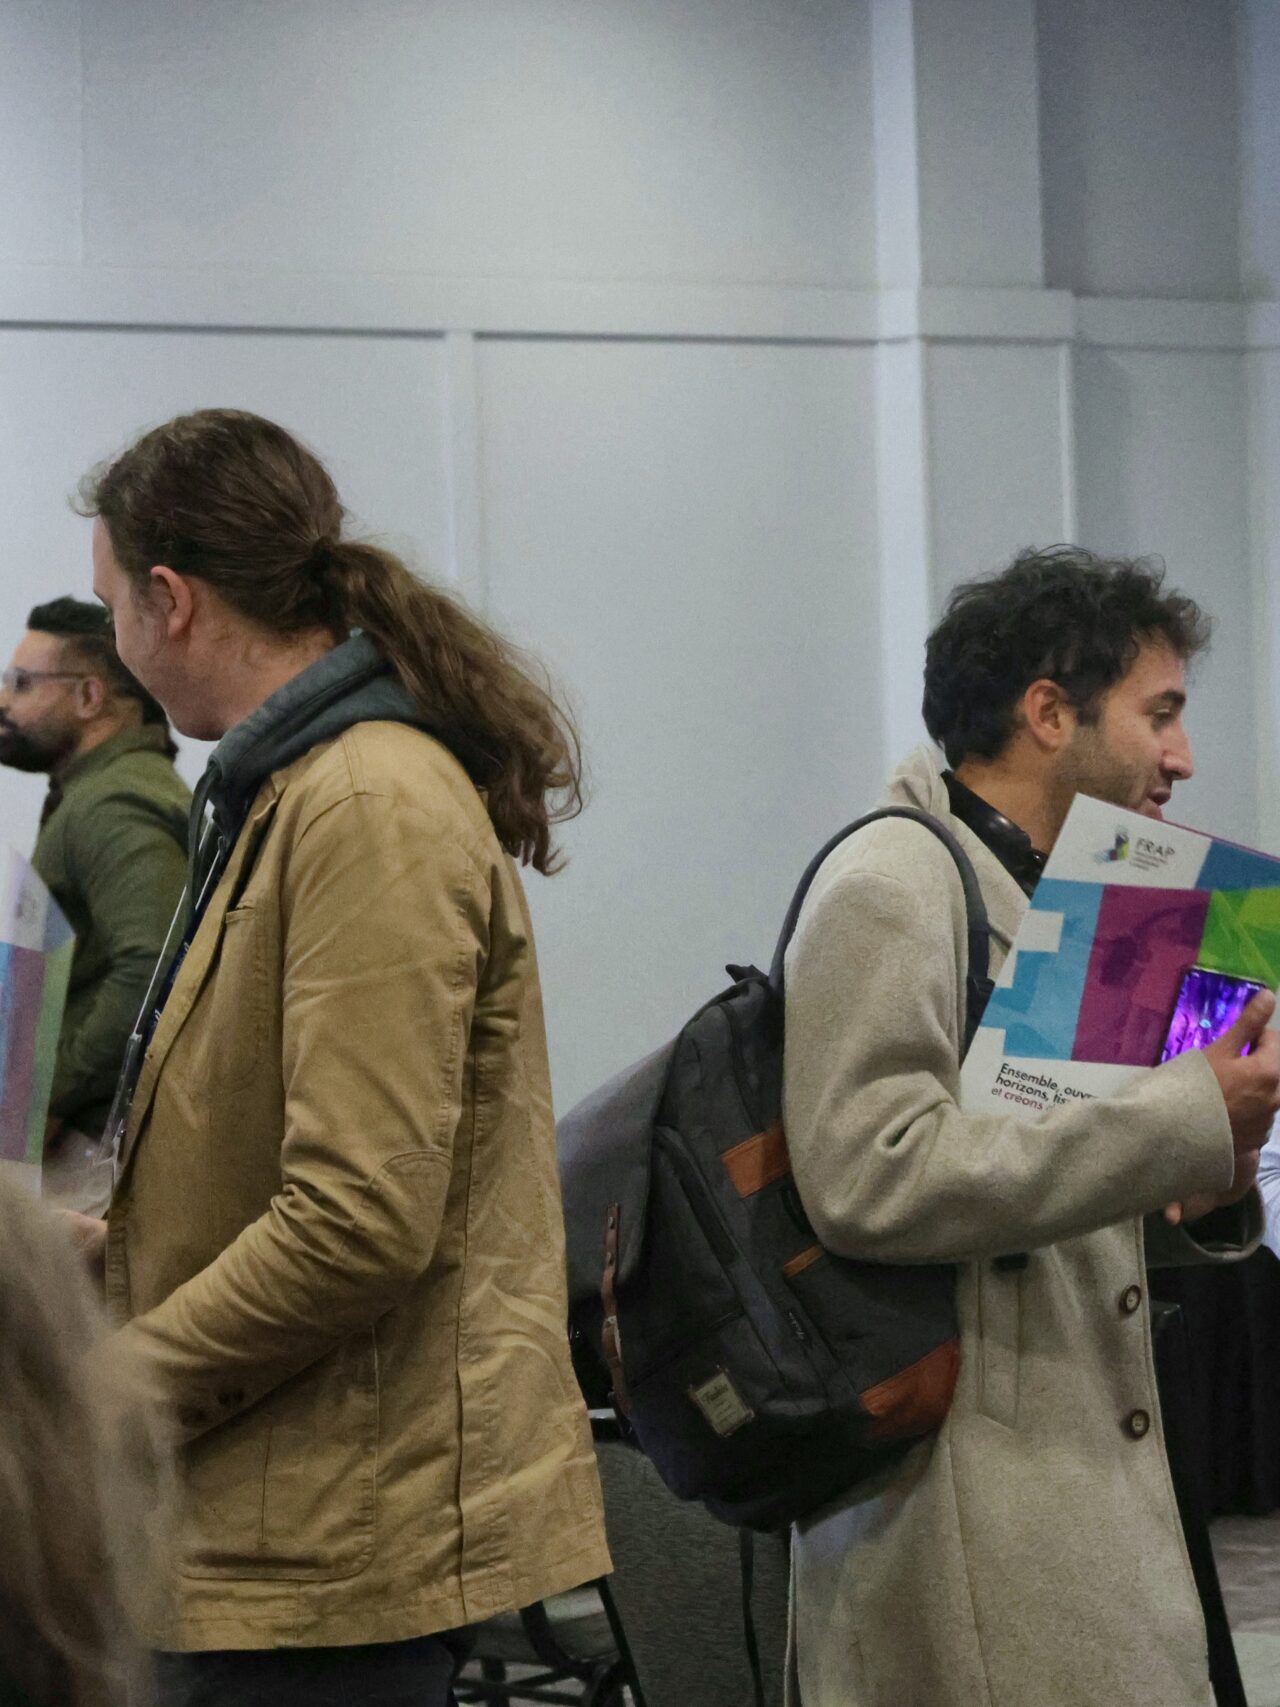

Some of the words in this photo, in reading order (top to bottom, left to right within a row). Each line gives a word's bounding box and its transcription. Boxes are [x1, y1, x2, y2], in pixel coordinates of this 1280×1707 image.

[1136, 837, 1176, 859] FRAP
[995, 1073, 1049, 1101] horizons,
[1000, 1062, 1060, 1093] Ensemble,
[991, 1086, 1002, 1097] et
